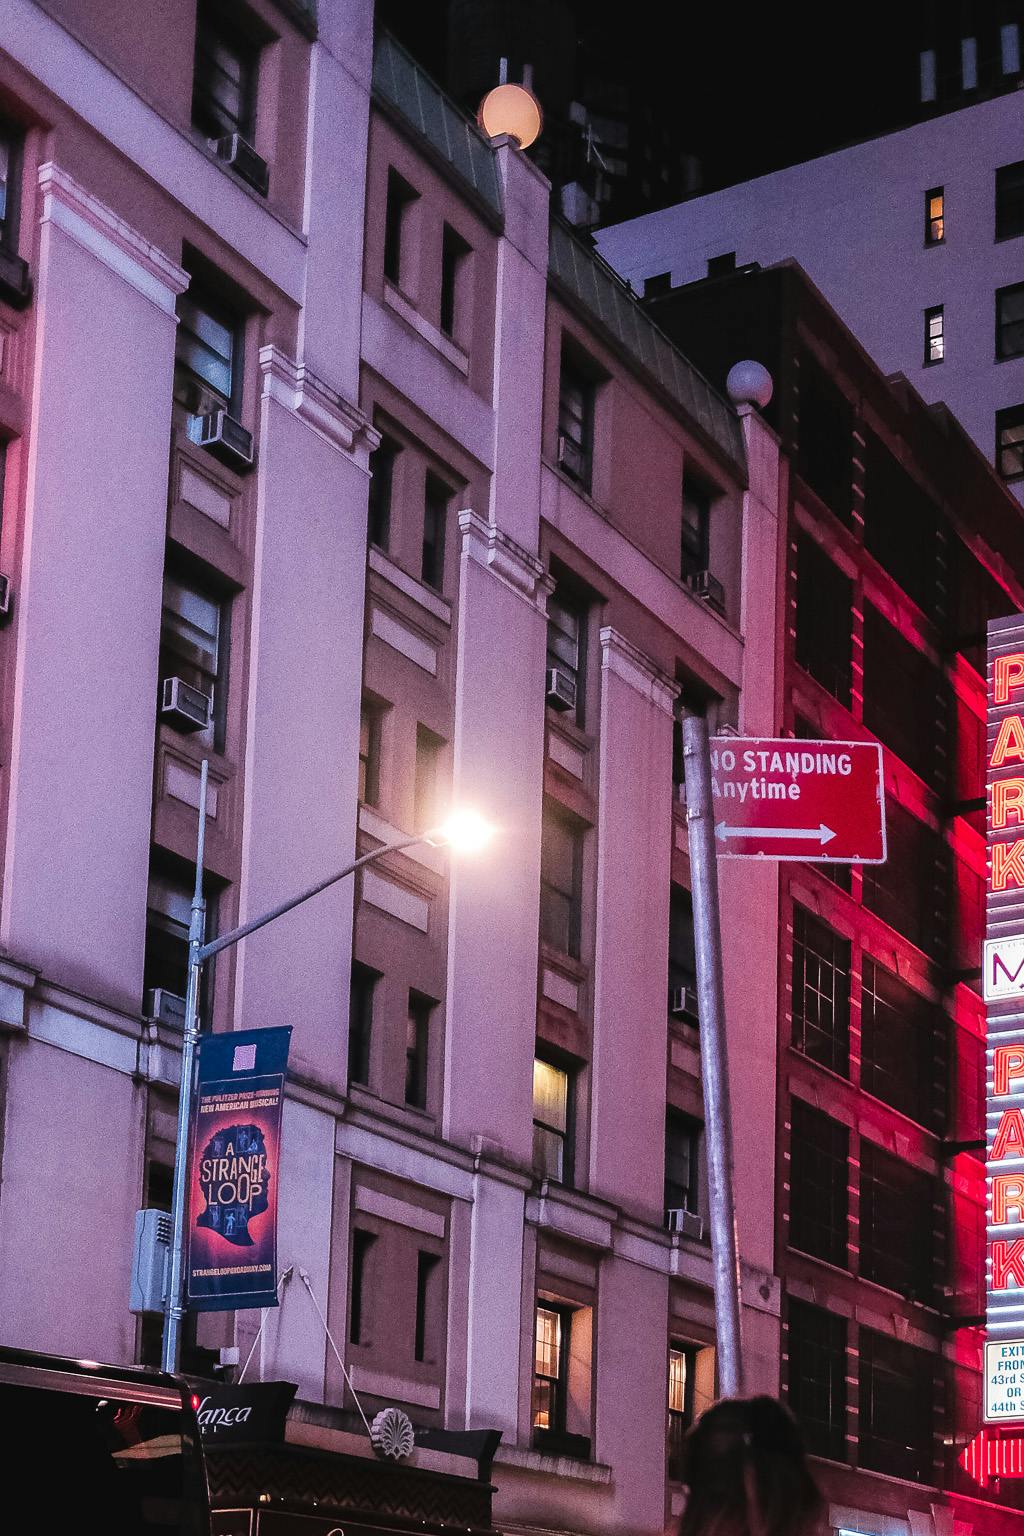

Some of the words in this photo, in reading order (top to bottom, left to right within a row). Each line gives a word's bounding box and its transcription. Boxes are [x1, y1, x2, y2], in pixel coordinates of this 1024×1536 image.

[743, 751, 852, 775] STANDING
[711, 777, 801, 802] Anytime
[200, 1104, 215, 1113] NEW
[215, 1101, 249, 1112] AMERICAN
[225, 1142, 235, 1156] A
[202, 1154, 265, 1183] STRANGE
[208, 1173, 262, 1212] LOOP
[991, 1373, 1016, 1385] 43rd
[1006, 1387, 1022, 1398] OR
[991, 1401, 1016, 1412] 44th
